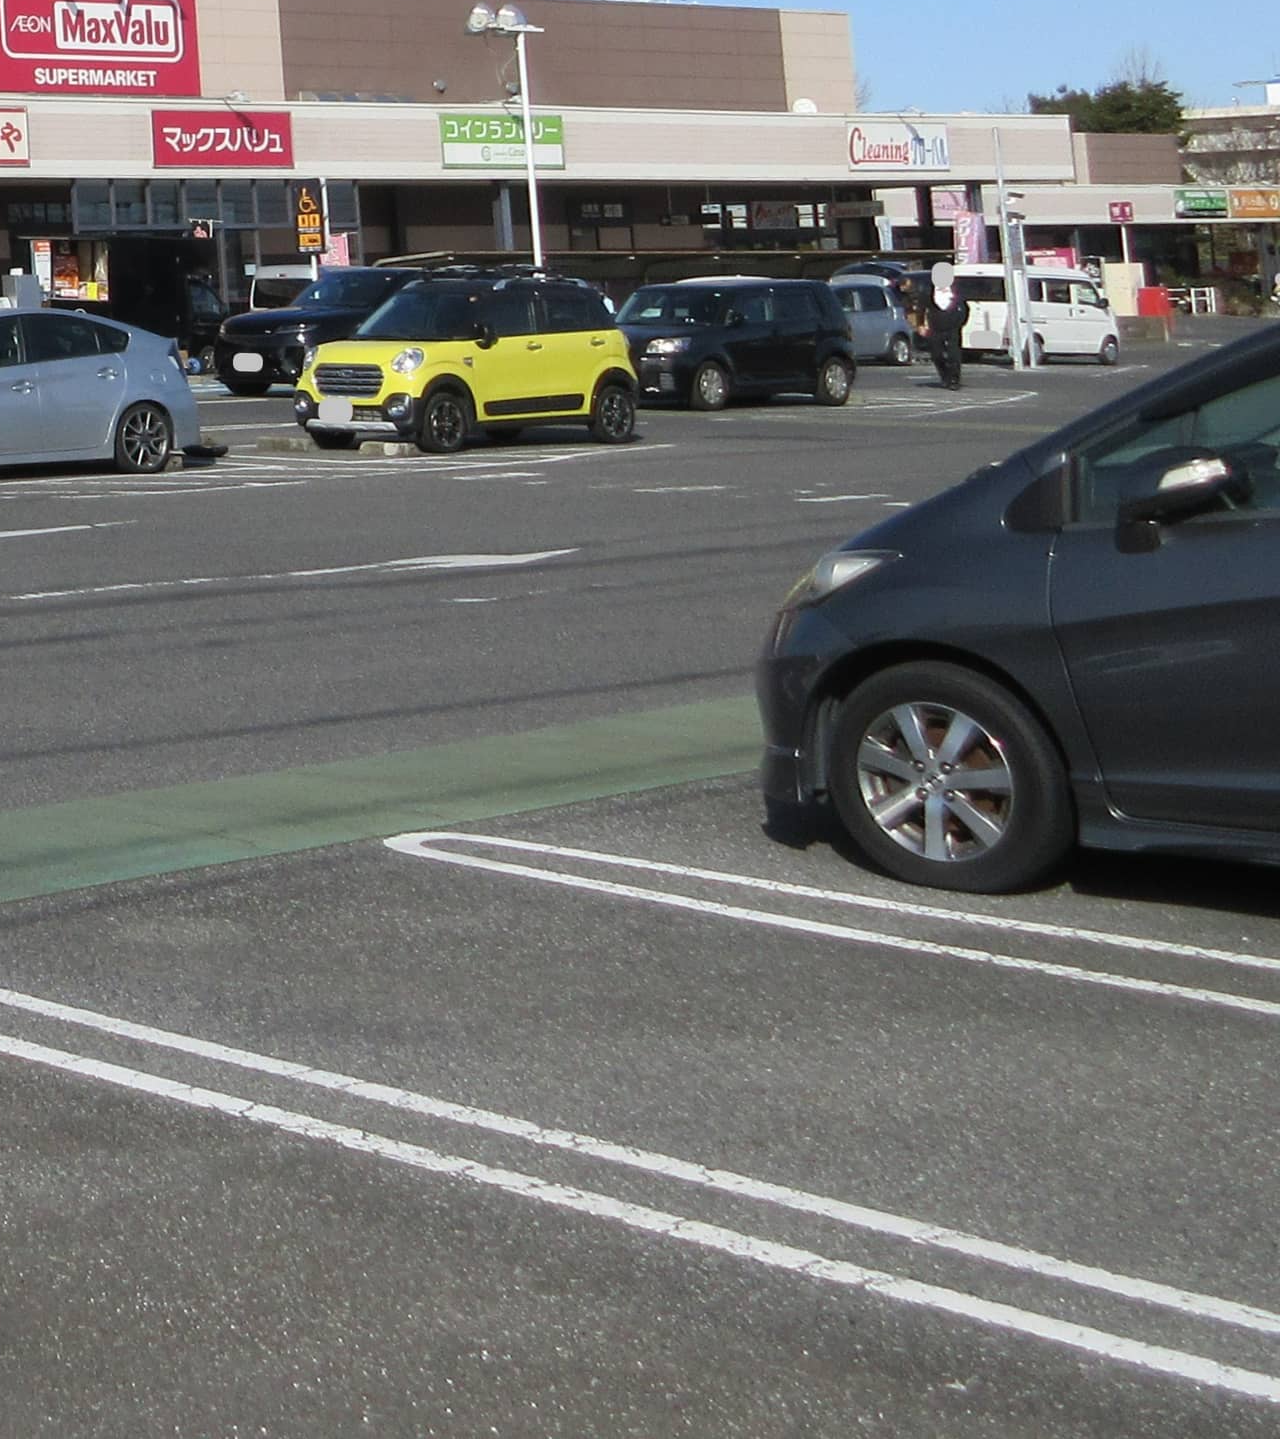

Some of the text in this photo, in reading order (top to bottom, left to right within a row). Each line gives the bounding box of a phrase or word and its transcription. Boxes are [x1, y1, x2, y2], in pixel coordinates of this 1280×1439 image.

[34, 67, 157, 87] SUPERMARKET
[162, 127, 284, 152] マックスバリュ
[850, 127, 910, 165] Cleaning
